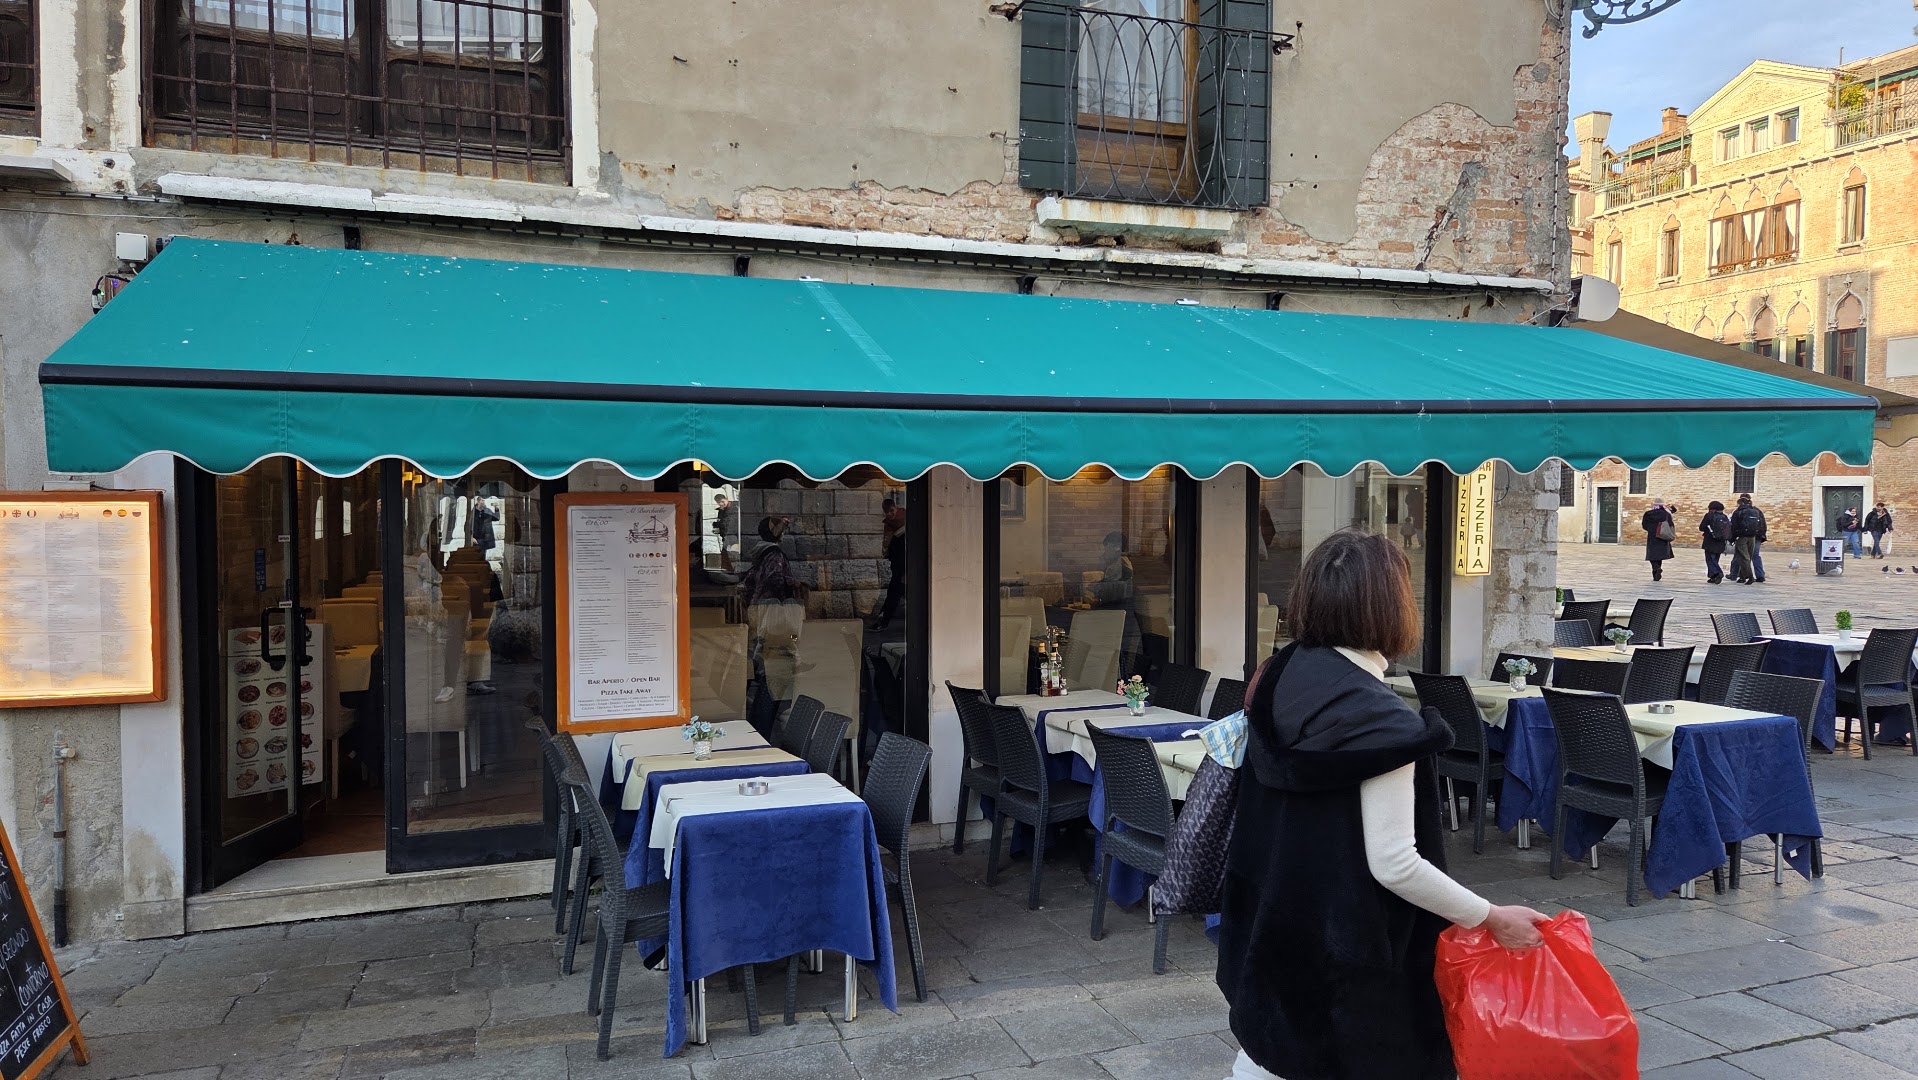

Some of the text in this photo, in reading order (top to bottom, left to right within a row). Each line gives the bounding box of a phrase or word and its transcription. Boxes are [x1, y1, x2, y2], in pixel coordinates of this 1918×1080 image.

[1479, 461, 1491, 471] AR
[1458, 476, 1466, 568] IZZERIA
[1472, 474, 1486, 568] PIZZERIA
[10, 1021, 26, 1042] FATTA
[27, 1013, 35, 1024] IN
[37, 995, 52, 1015] CASA
[14, 1016, 51, 1063] PESCE FRESCO
